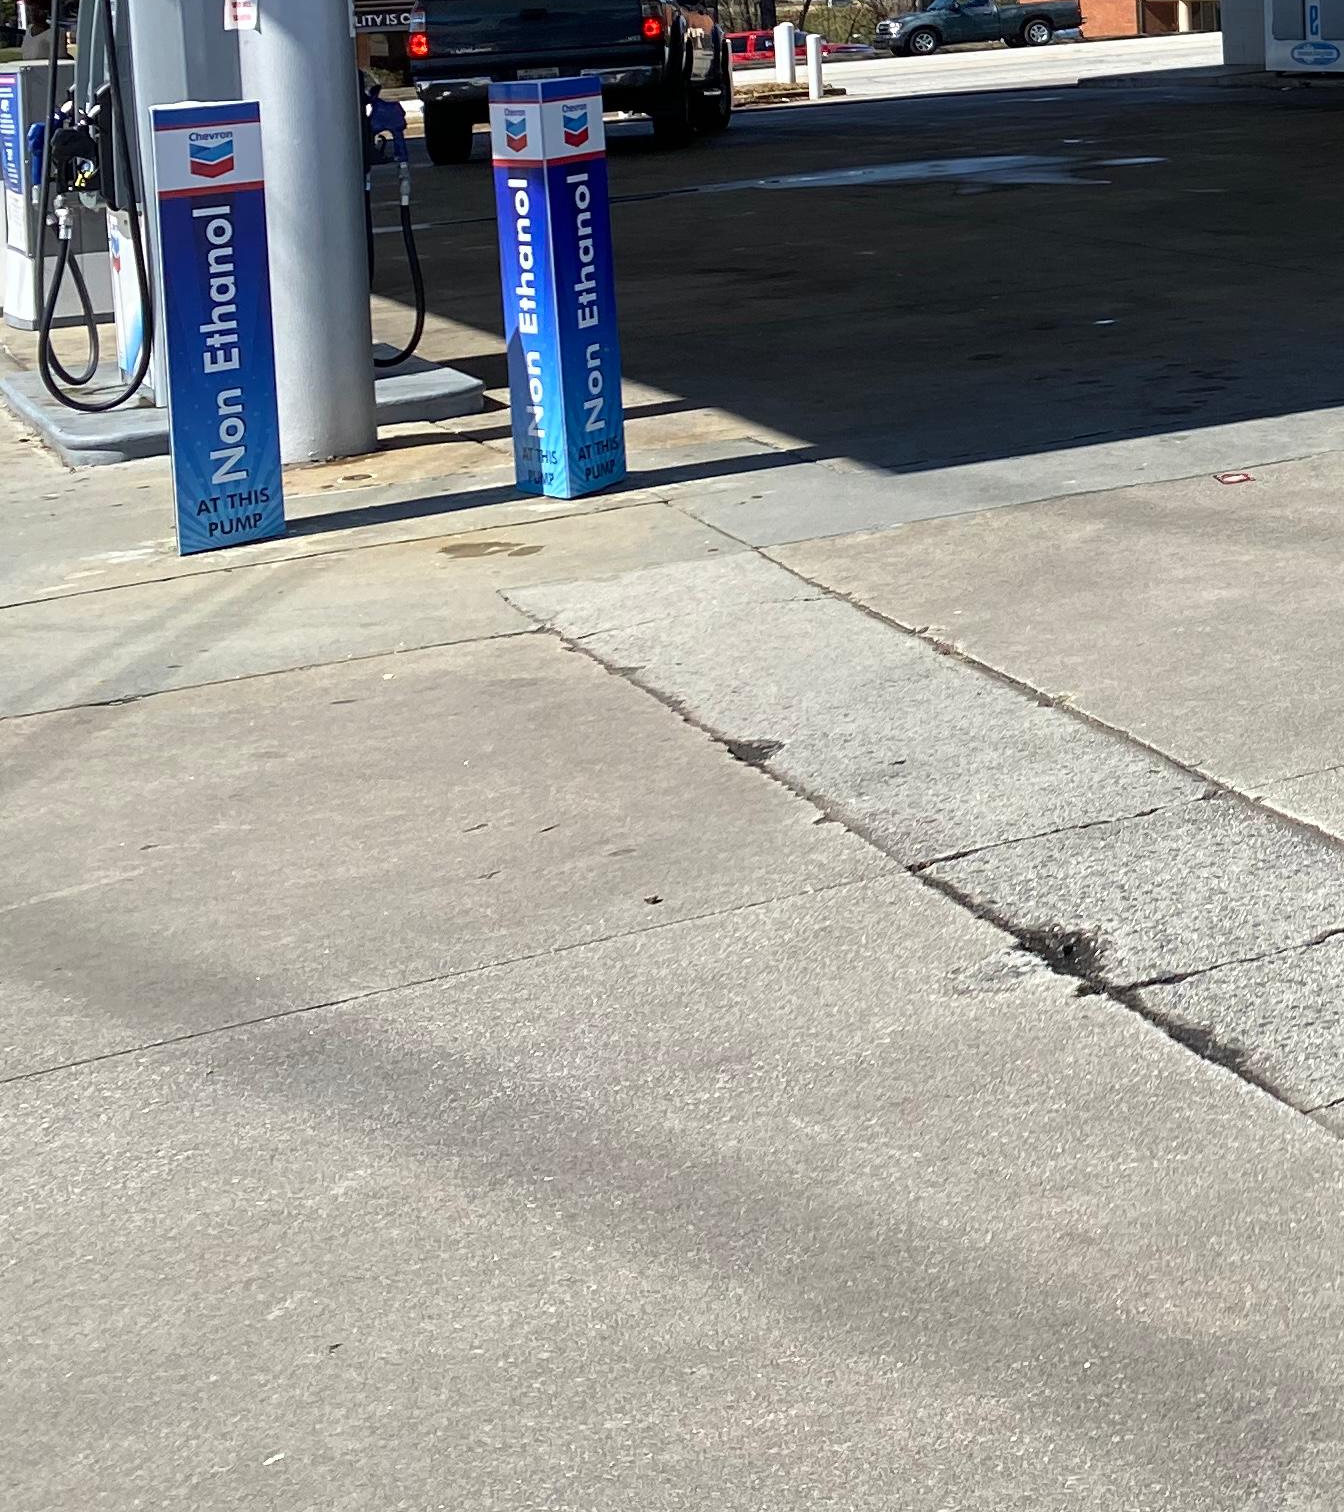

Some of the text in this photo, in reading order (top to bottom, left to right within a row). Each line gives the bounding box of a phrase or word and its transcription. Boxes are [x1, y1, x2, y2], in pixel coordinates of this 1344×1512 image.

[355, 14, 382, 27] LITY
[386, 13, 398, 25] IS
[188, 131, 233, 142] Chevron
[507, 178, 545, 438] Non Ethanol
[566, 173, 606, 433] Non Ethanol
[192, 205, 248, 485] Non Ethanol
[579, 435, 619, 462] AT THIS
[585, 459, 616, 482] PUMP
[196, 487, 270, 516] AT THIS
[208, 512, 263, 538] PUMP
